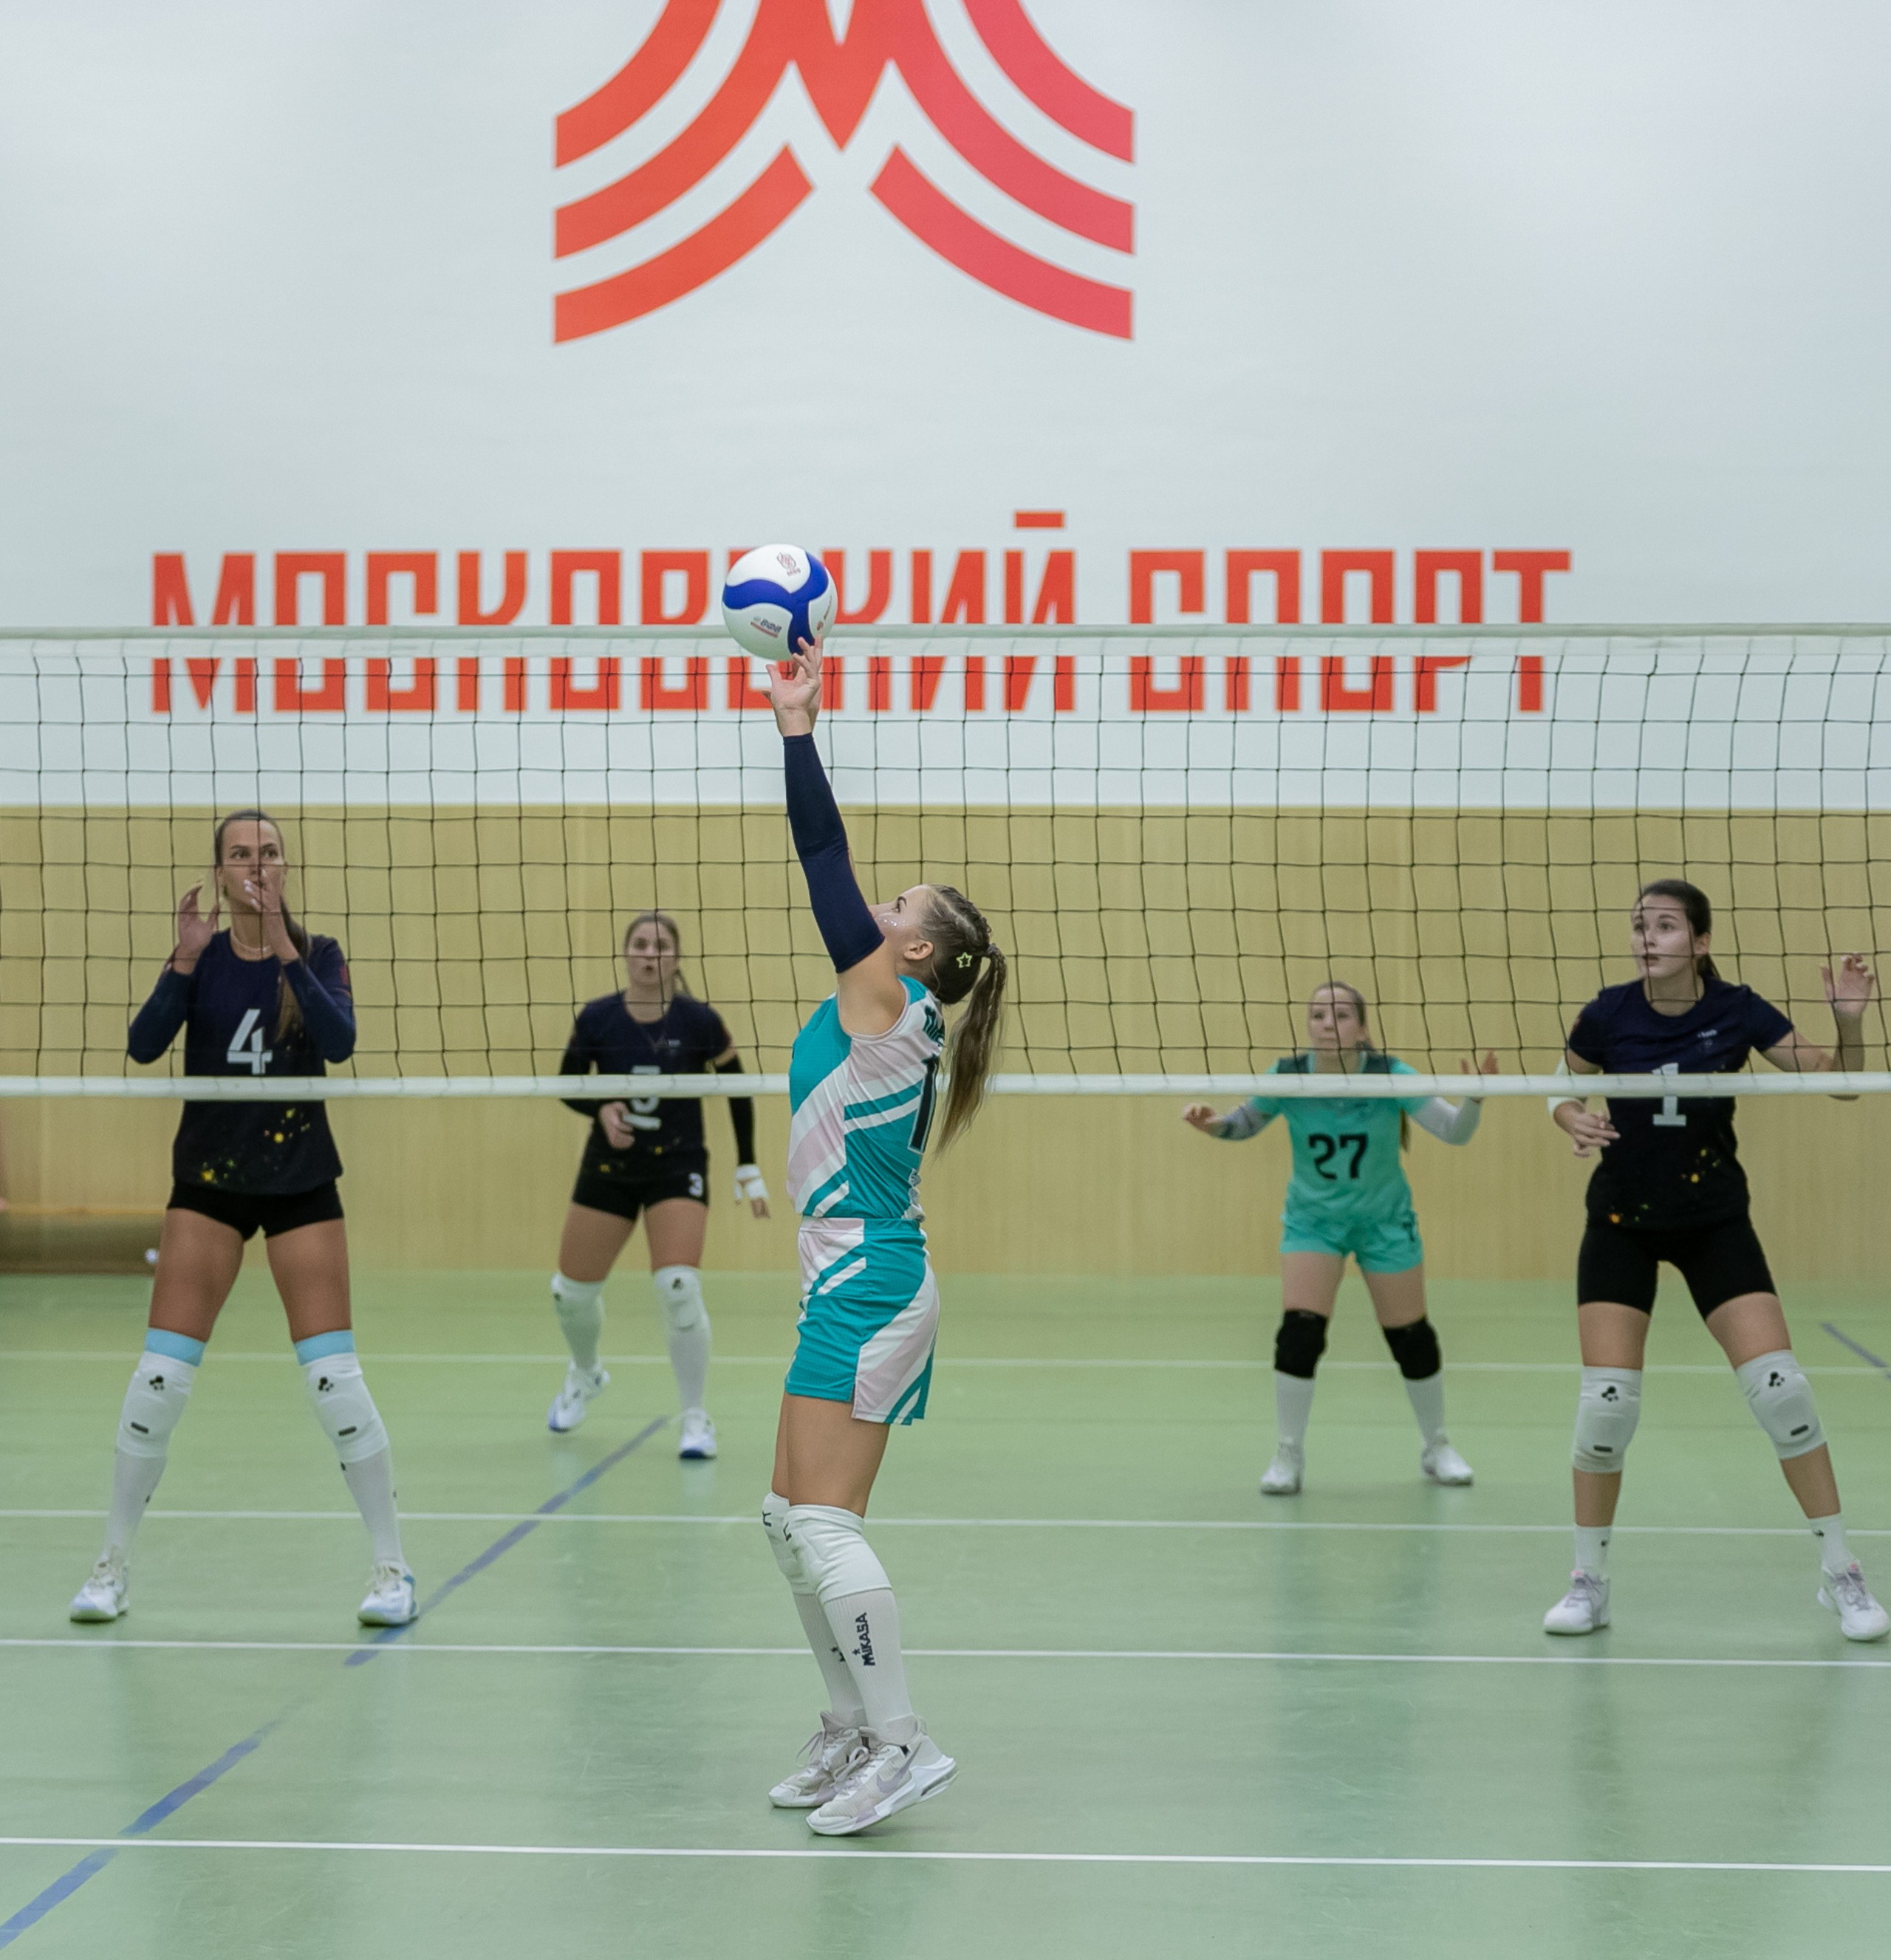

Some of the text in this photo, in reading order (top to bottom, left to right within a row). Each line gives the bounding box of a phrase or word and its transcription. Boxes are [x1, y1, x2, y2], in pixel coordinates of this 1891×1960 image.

[1129, 549, 1570, 712] СПОРТ
[227, 1008, 273, 1075] 4
[1652, 1062, 1687, 1127] 1
[1308, 1133, 1369, 1181] 27
[855, 1612, 876, 1666] MIKASA
